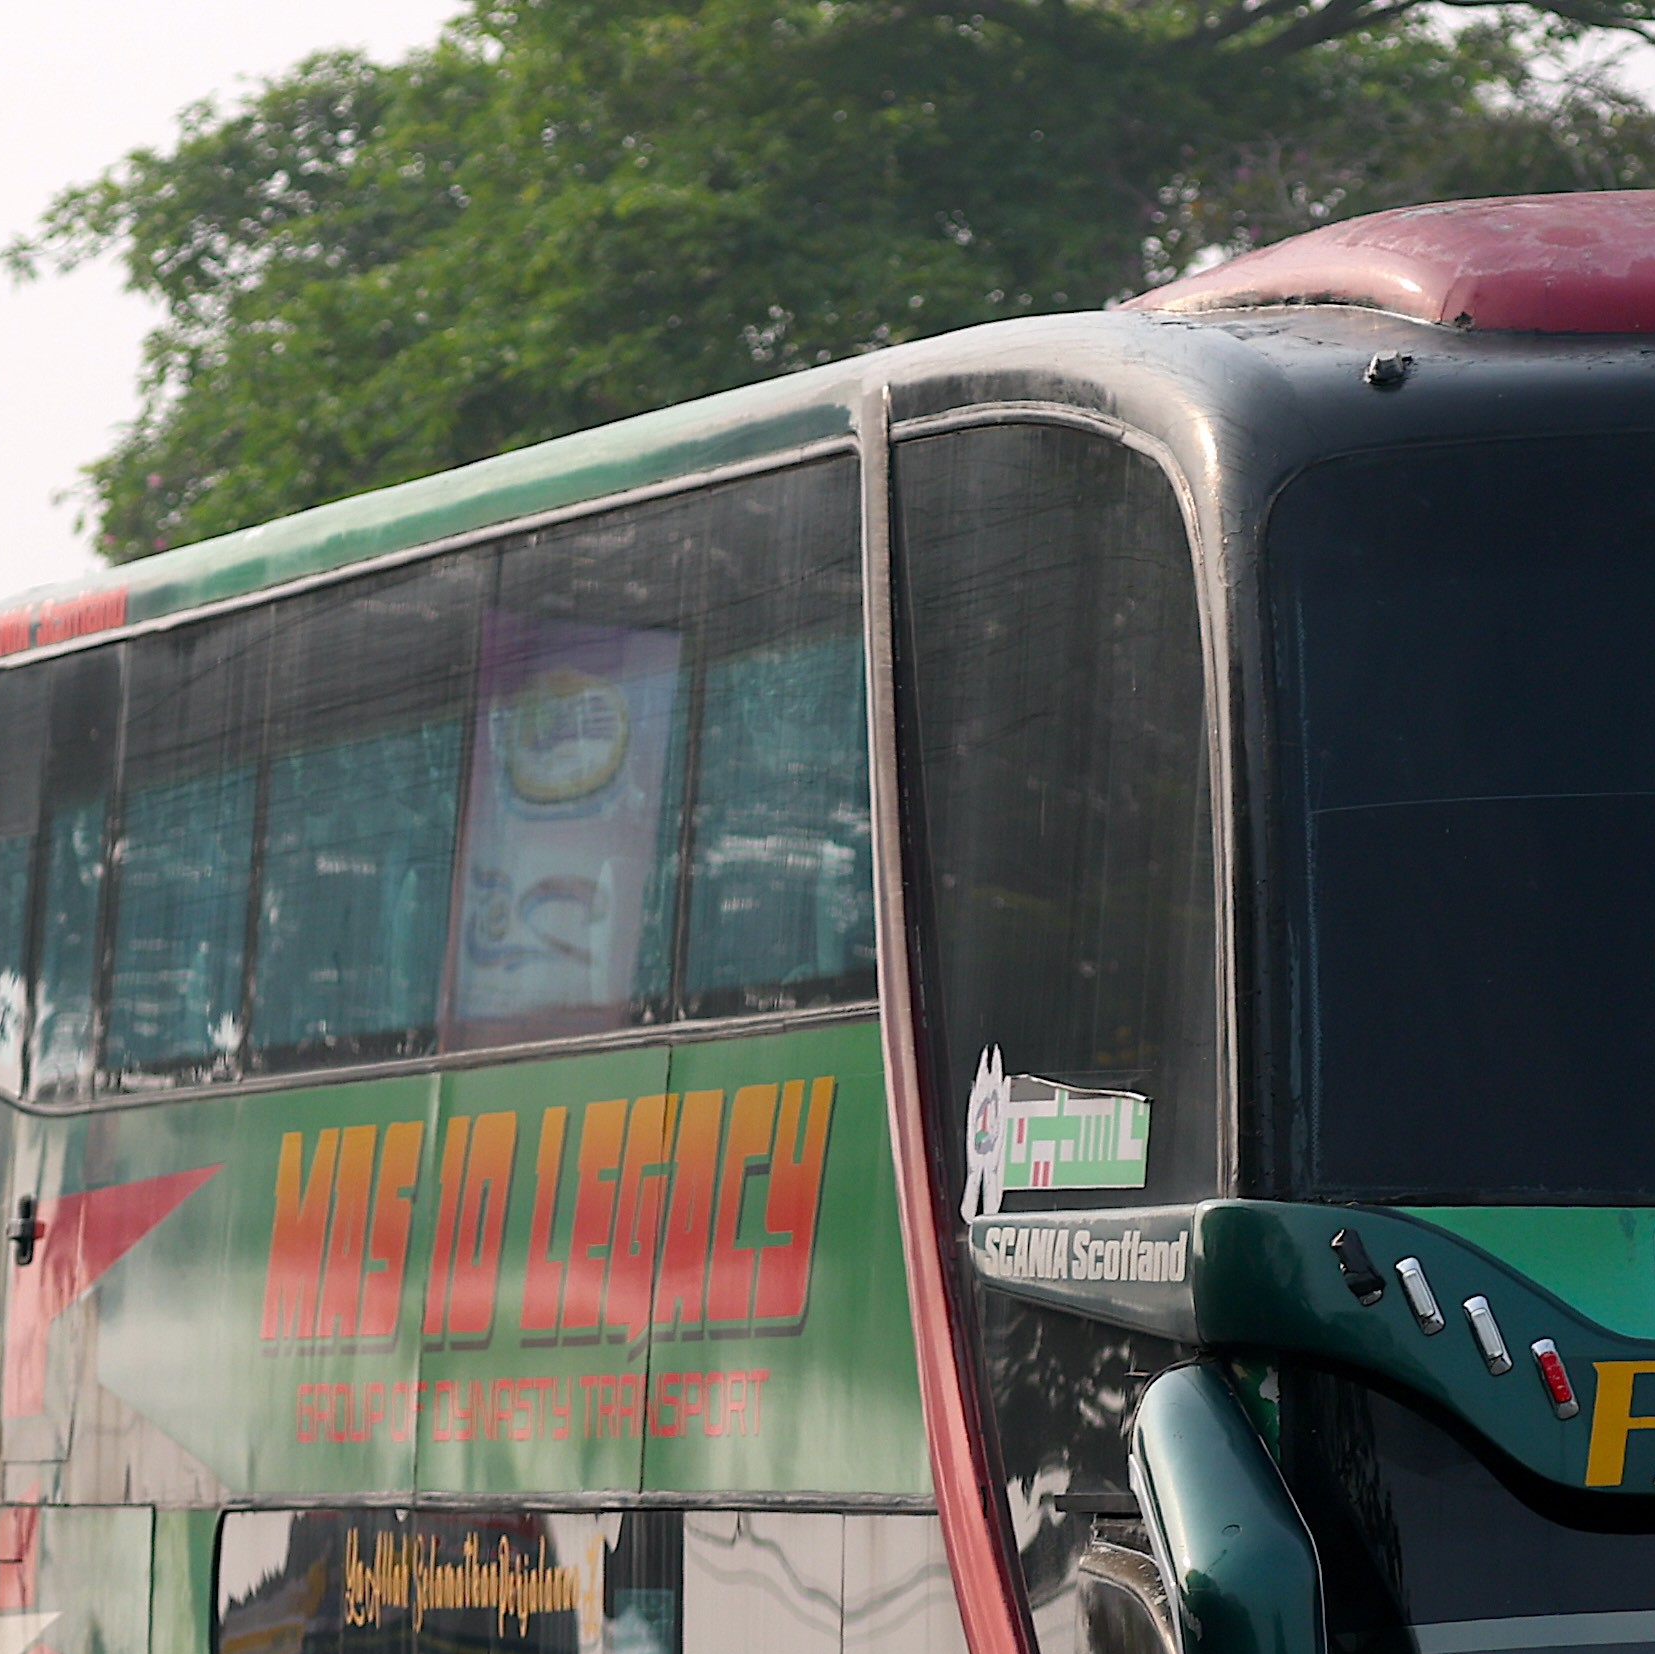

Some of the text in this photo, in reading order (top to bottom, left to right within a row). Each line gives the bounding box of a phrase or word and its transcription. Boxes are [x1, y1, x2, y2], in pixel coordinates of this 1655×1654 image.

[259, 1120, 425, 1341] MAS
[518, 1075, 836, 1344] LEGACY
[984, 1227, 1189, 1282] SCANIA Scotland
[295, 1368, 770, 1445] GROUP OF DYNASTY TRANSPORT
